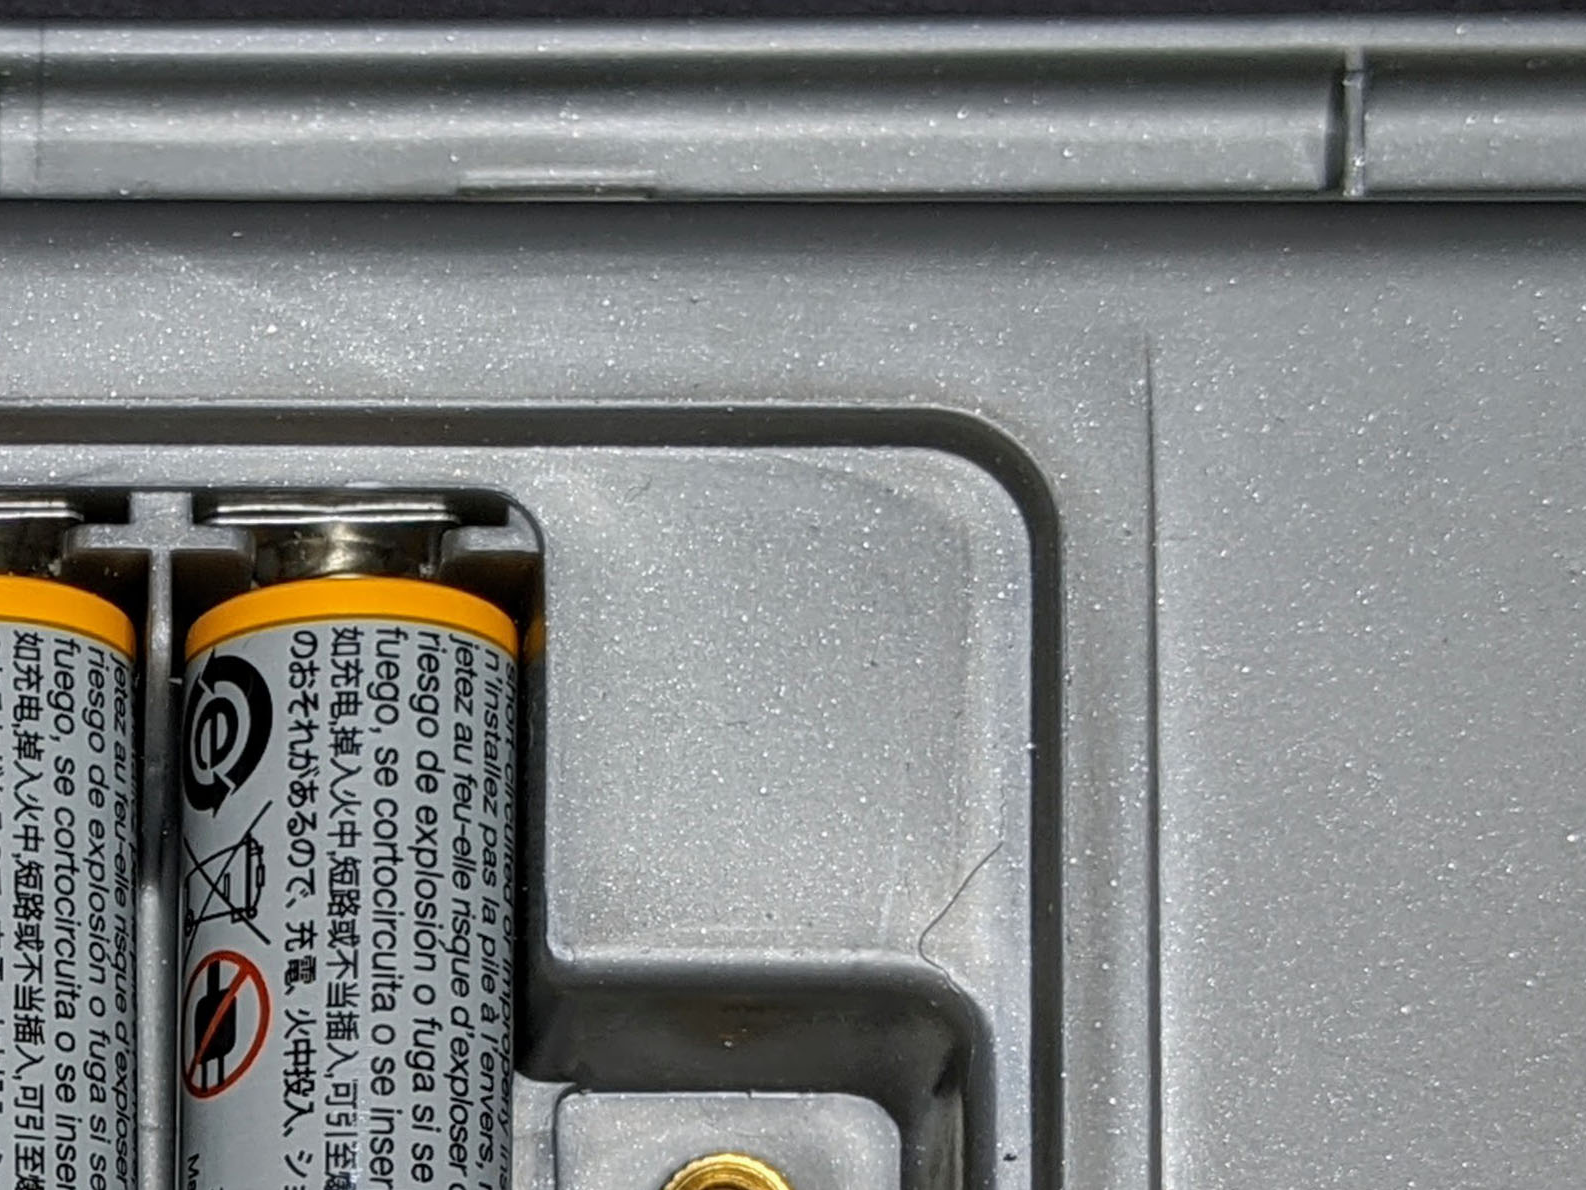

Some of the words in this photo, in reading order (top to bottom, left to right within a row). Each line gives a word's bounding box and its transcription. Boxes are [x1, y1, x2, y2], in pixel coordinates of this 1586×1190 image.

[45, 637, 82, 743] fuego,
[365, 626, 410, 734] fuego,
[407, 630, 448, 739] riesgo
[447, 634, 481, 718] jetez
[373, 746, 400, 788] se
[414, 749, 447, 795] de
[452, 721, 474, 766] au
[52, 754, 76, 797] se
[451, 772, 479, 892] feu-elle
[53, 805, 83, 1021] cortocircuita
[370, 797, 406, 1014] cortocircuita
[406, 804, 448, 972] explosión
[441, 897, 477, 999] risque
[412, 983, 437, 1006] o
[54, 1030, 76, 1054] o
[370, 1023, 397, 1046] o
[403, 1016, 444, 1093] fuga
[54, 1062, 77, 1104] se
[369, 1055, 397, 1097] se
[442, 1005, 476, 1178] d'exploser
[411, 1103, 443, 1134] si
[410, 1142, 435, 1184] se
